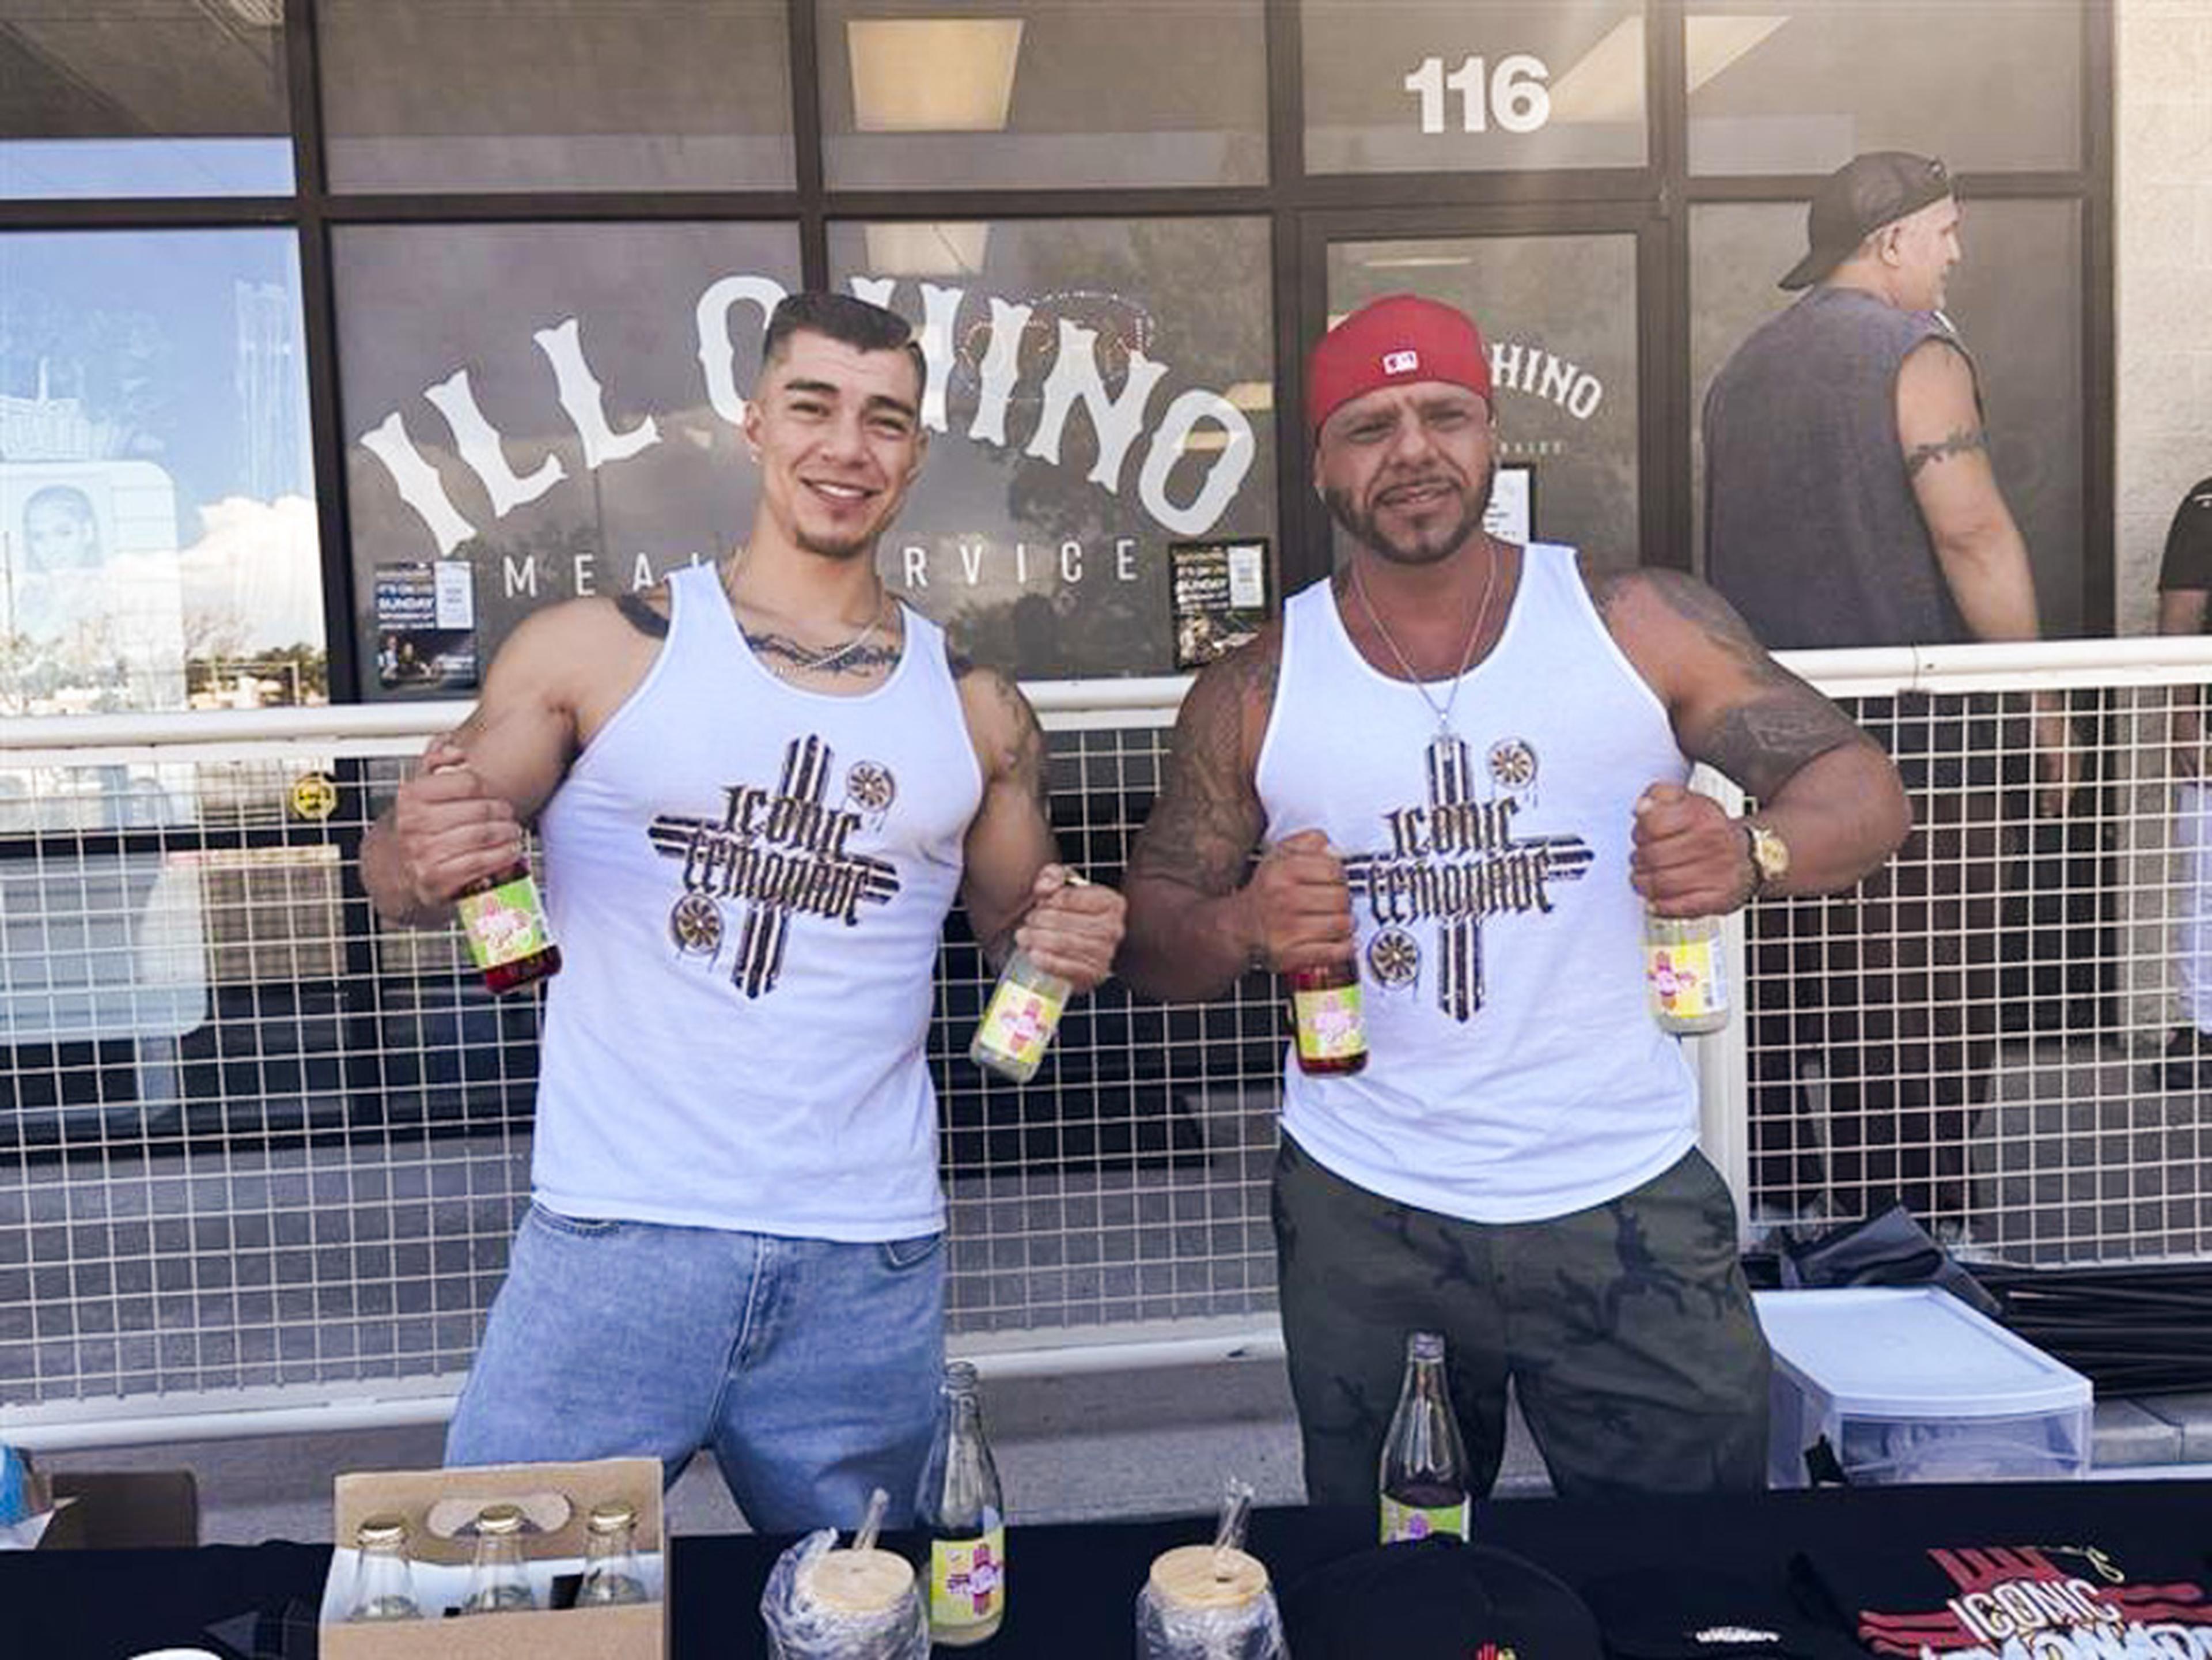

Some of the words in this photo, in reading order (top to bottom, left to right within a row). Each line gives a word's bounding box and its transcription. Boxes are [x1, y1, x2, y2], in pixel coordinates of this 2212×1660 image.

[1404, 56, 1551, 134] 116
[1482, 343, 1602, 419] HINO
[359, 317, 662, 556] ILL
[904, 539, 1138, 587] RVICE
[1946, 1579, 2122, 1643] ICONIC
